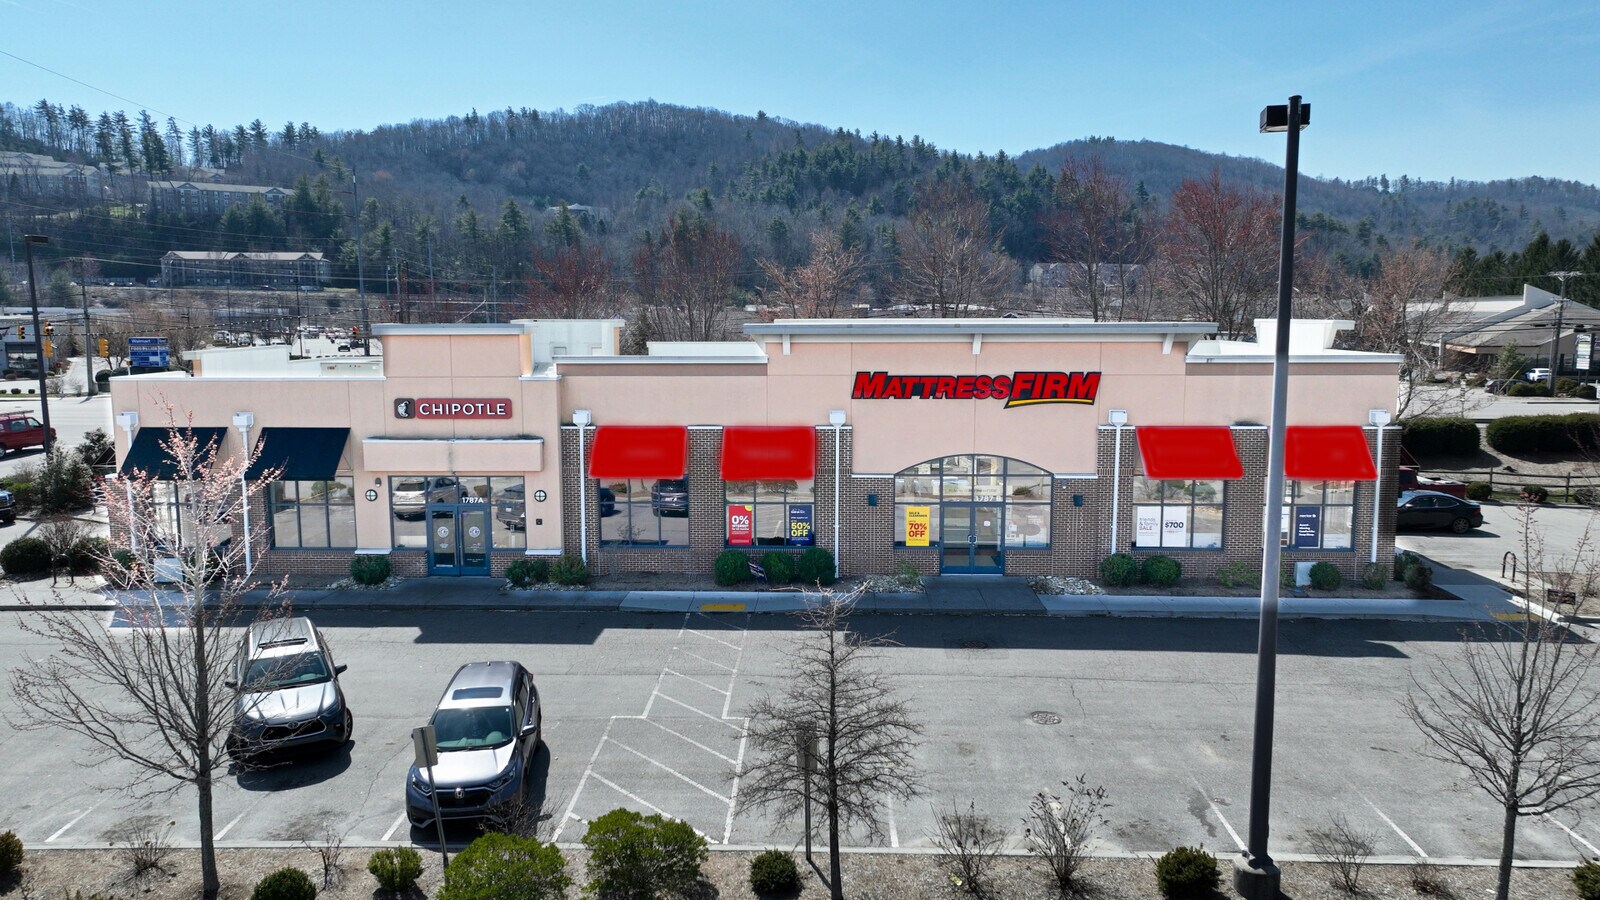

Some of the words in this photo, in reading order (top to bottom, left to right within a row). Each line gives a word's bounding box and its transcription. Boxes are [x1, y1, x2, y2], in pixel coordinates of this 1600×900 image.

[419, 403, 506, 416] CHIPOTLE
[732, 515, 749, 524] 0%
[791, 522, 810, 530] 50%
